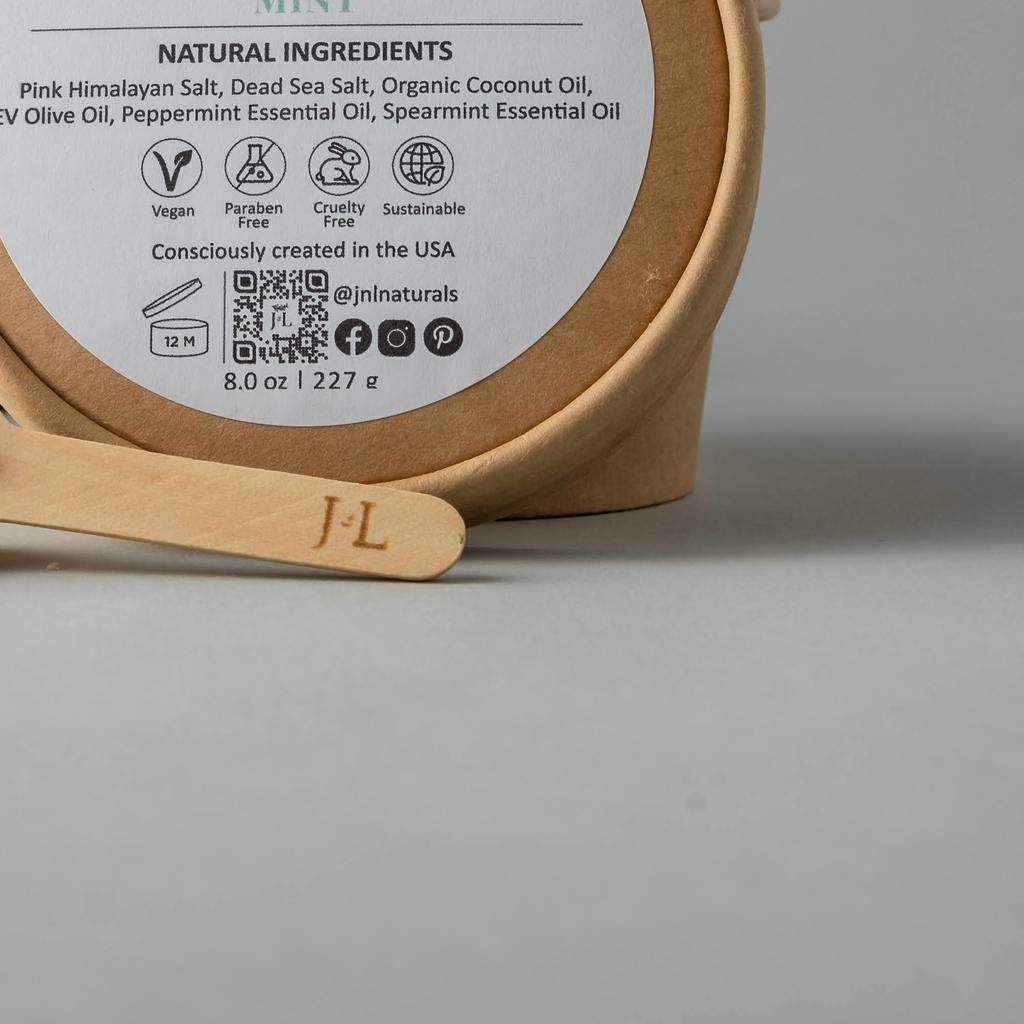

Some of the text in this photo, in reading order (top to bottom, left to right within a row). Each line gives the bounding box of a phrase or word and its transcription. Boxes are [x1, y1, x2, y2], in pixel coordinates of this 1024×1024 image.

[158, 40, 453, 64] NATURAL INGREDIENTS
[20, 75, 593, 102] Pink Himalayan Salt, Dead Sea Salt, Organic Coconut Oil,
[24, 106, 76, 125] Olive
[81, 104, 115, 127] Oil,
[122, 103, 242, 127] Peppermint
[247, 101, 337, 122] Essential
[342, 101, 377, 124] Oil,
[383, 101, 490, 124] Spearmint
[496, 101, 586, 120] Essential
[591, 101, 620, 121] Oil
[151, 204, 195, 221] Vegan
[225, 201, 283, 215] Paraben
[313, 200, 366, 217] Cruelty
[382, 201, 466, 216] Sustainable
[238, 215, 270, 229] Free
[323, 215, 355, 228] Free
[151, 240, 456, 263] Consciously created in the USA
[333, 284, 459, 307] @jnlnaturals
[164, 335, 196, 348] 12 M
[223, 371, 258, 391] 8.0
[263, 375, 288, 390] oz
[313, 371, 357, 391] 227
[366, 375, 379, 390] g
